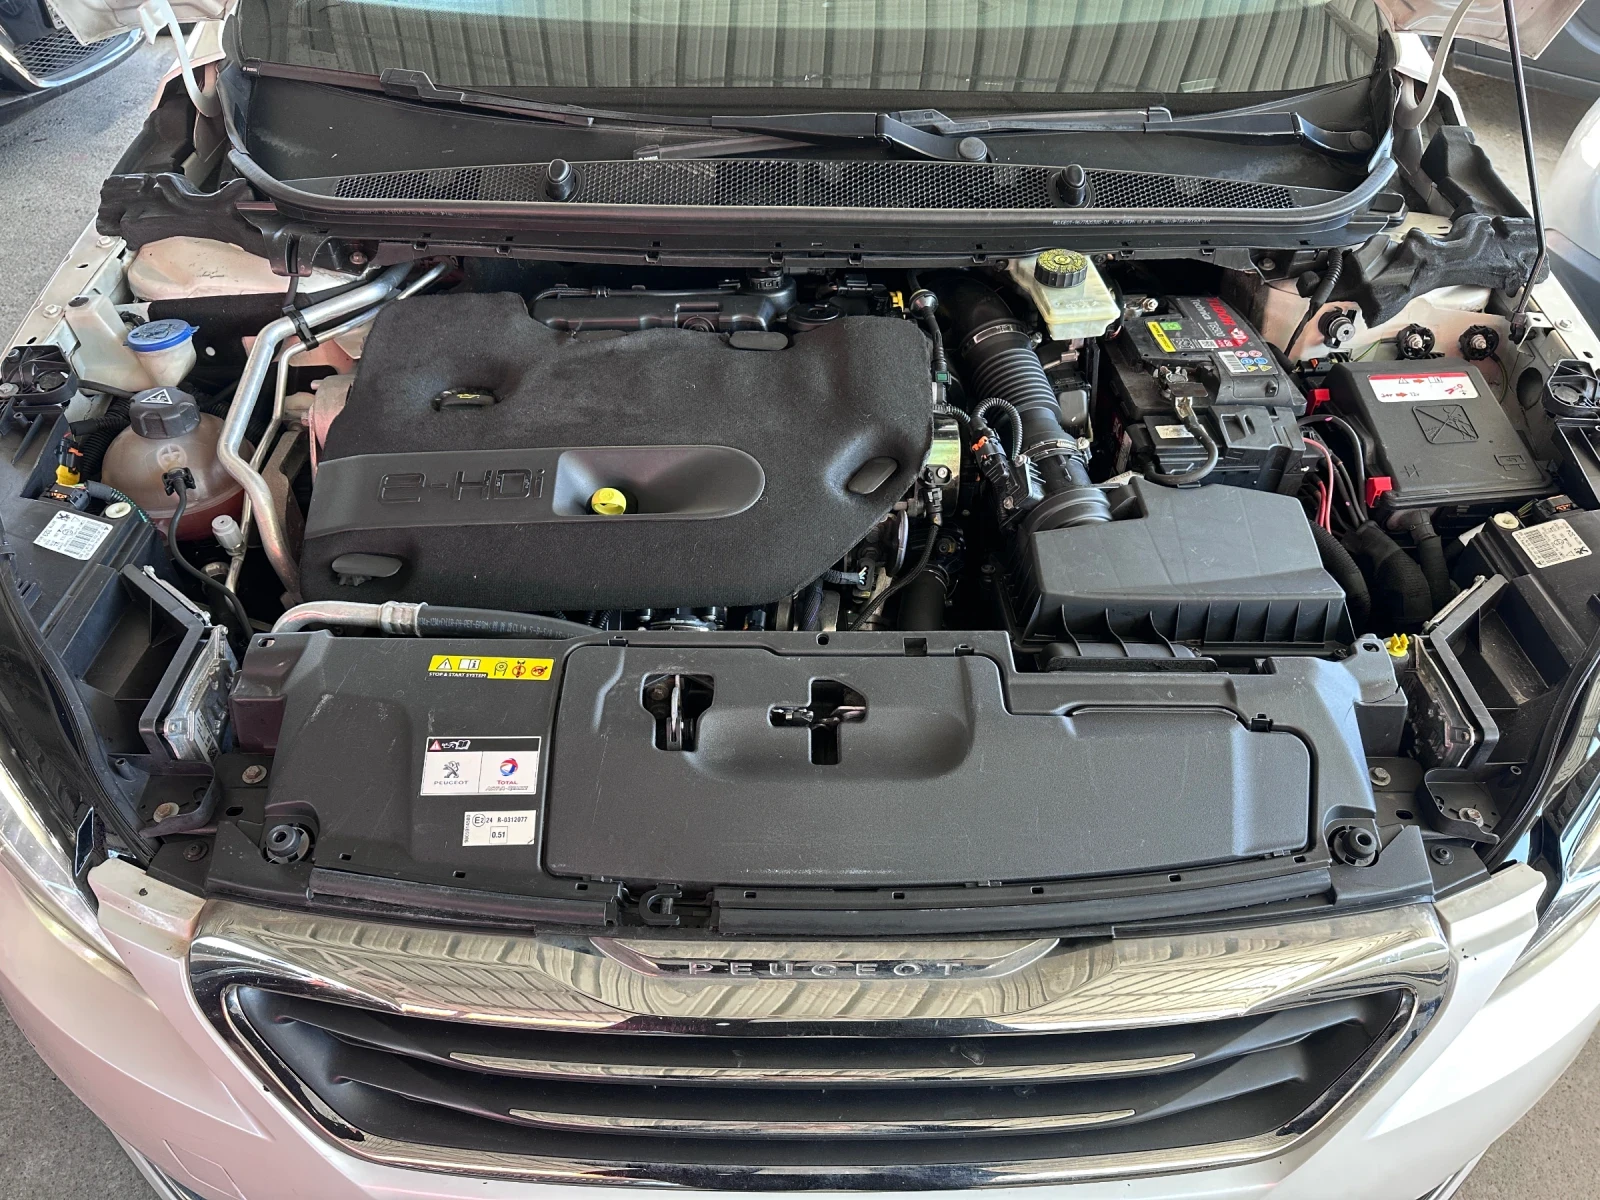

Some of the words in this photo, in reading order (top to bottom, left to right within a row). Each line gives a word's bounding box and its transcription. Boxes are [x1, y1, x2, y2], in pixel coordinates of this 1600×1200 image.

[1206, 297, 1236, 326] TUDOR
[377, 468, 546, 505] e-HDi
[491, 831, 506, 839] 0.51
[688, 961, 963, 977] PEUGEOT
